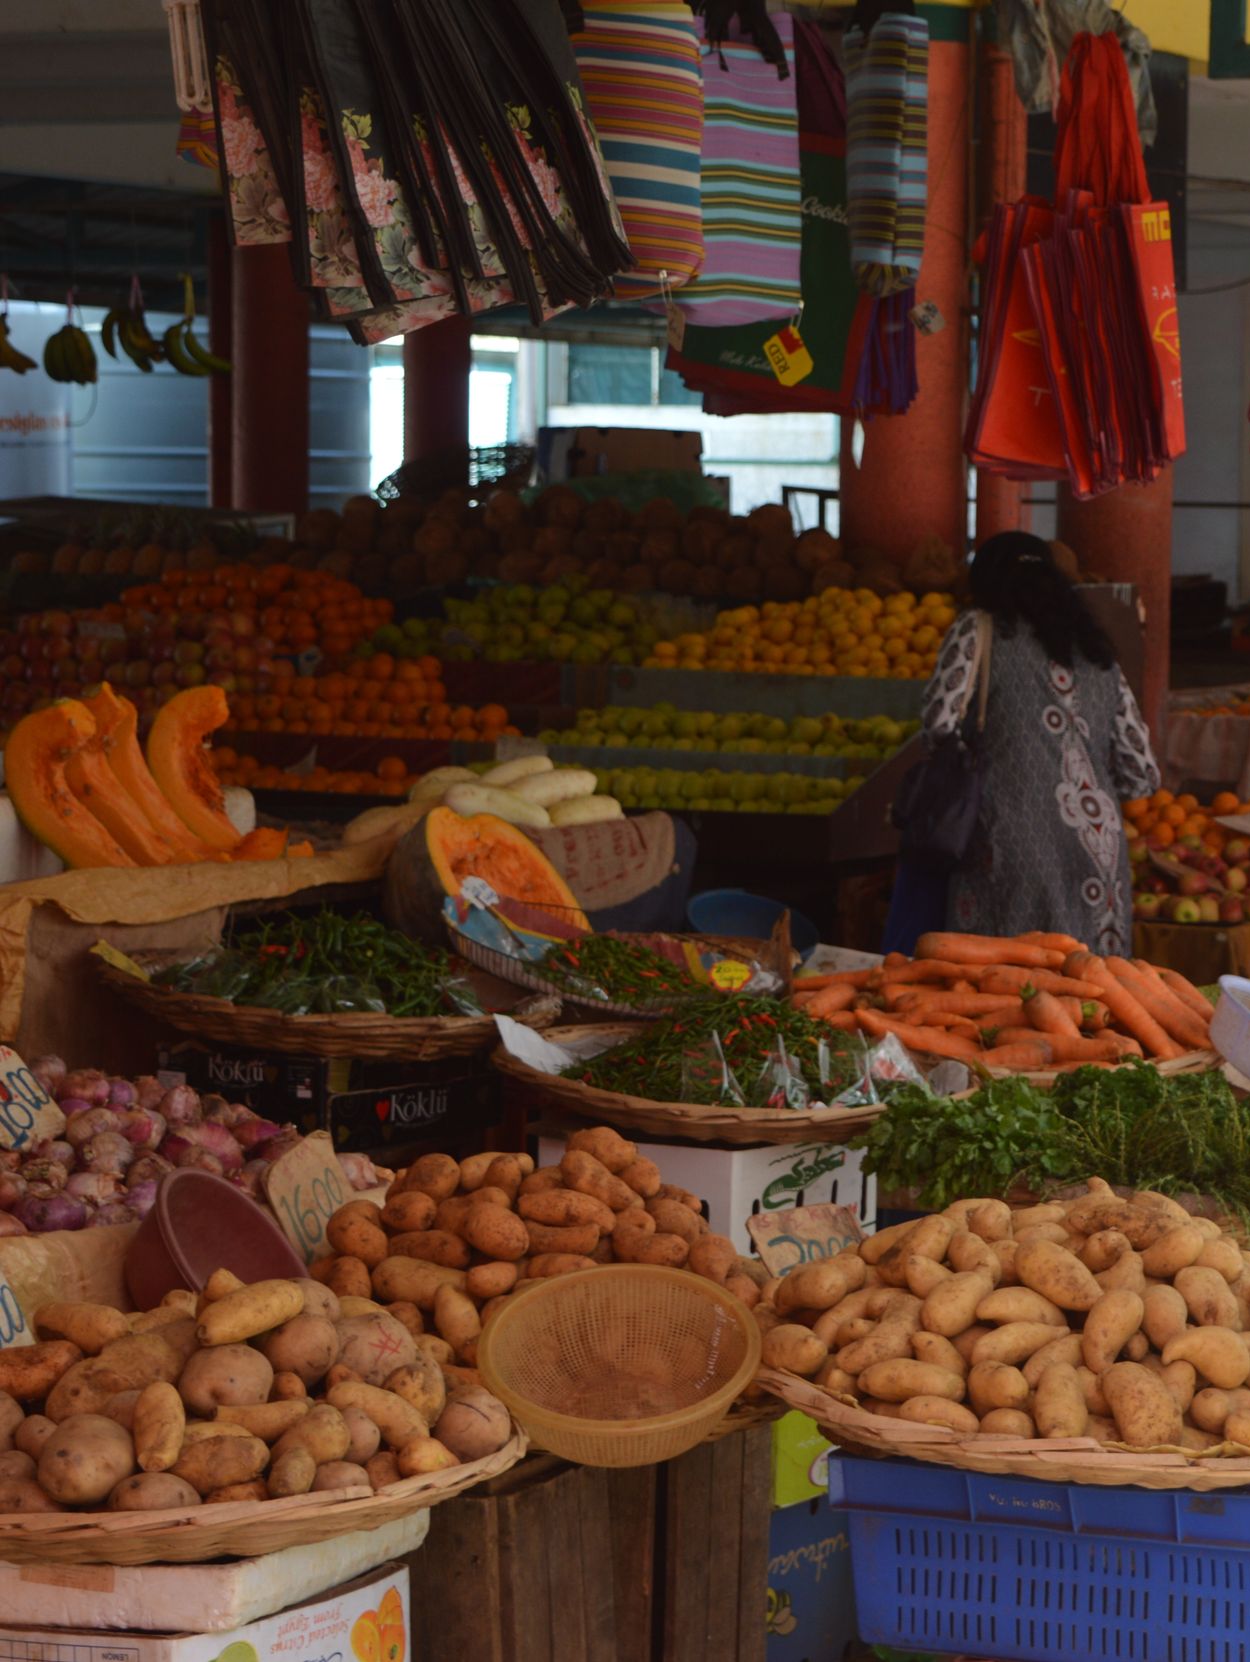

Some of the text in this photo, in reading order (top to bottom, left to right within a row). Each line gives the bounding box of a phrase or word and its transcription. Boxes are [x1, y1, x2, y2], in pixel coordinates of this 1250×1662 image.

[389, 1089, 447, 1123] Köklü
[280, 1167, 344, 1264] 1600
[101, 1652, 129, 1661] LEMON
